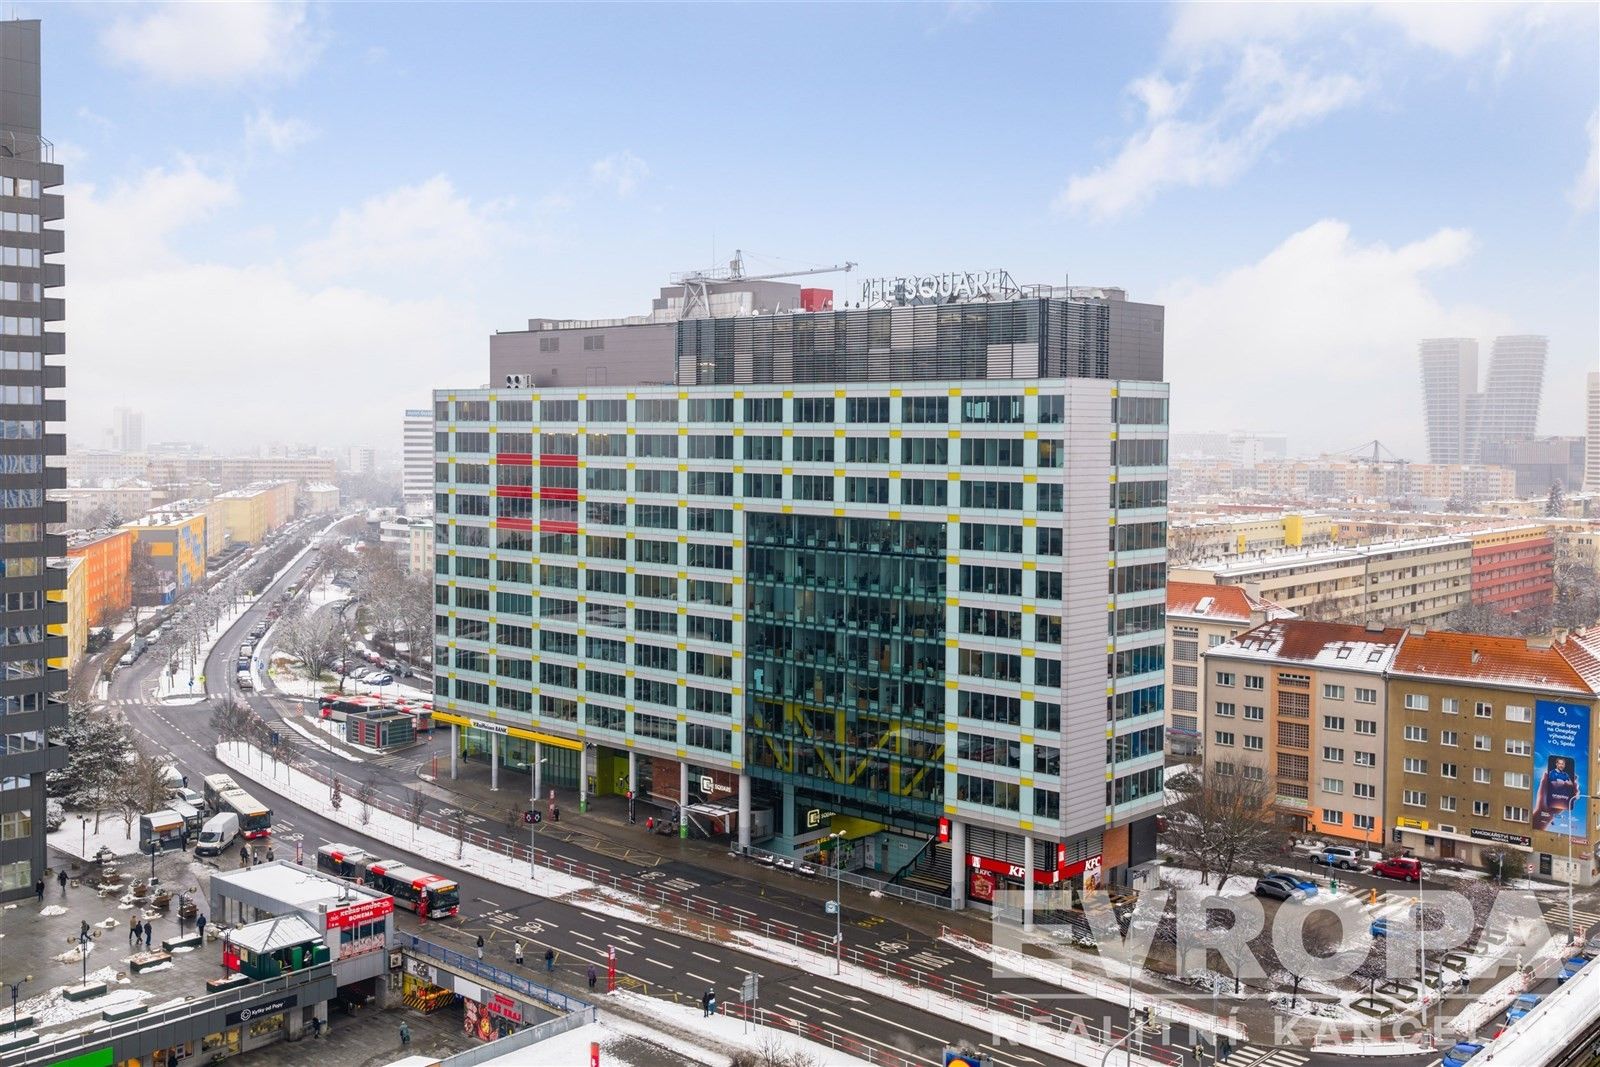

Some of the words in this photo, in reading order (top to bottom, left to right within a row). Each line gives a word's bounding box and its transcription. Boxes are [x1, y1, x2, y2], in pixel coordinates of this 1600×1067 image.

[904, 269, 1002, 299] SQUARE
[1085, 856, 1101, 871] KFC
[979, 868, 992, 877] KFC
[1009, 865, 1026, 878] KF
